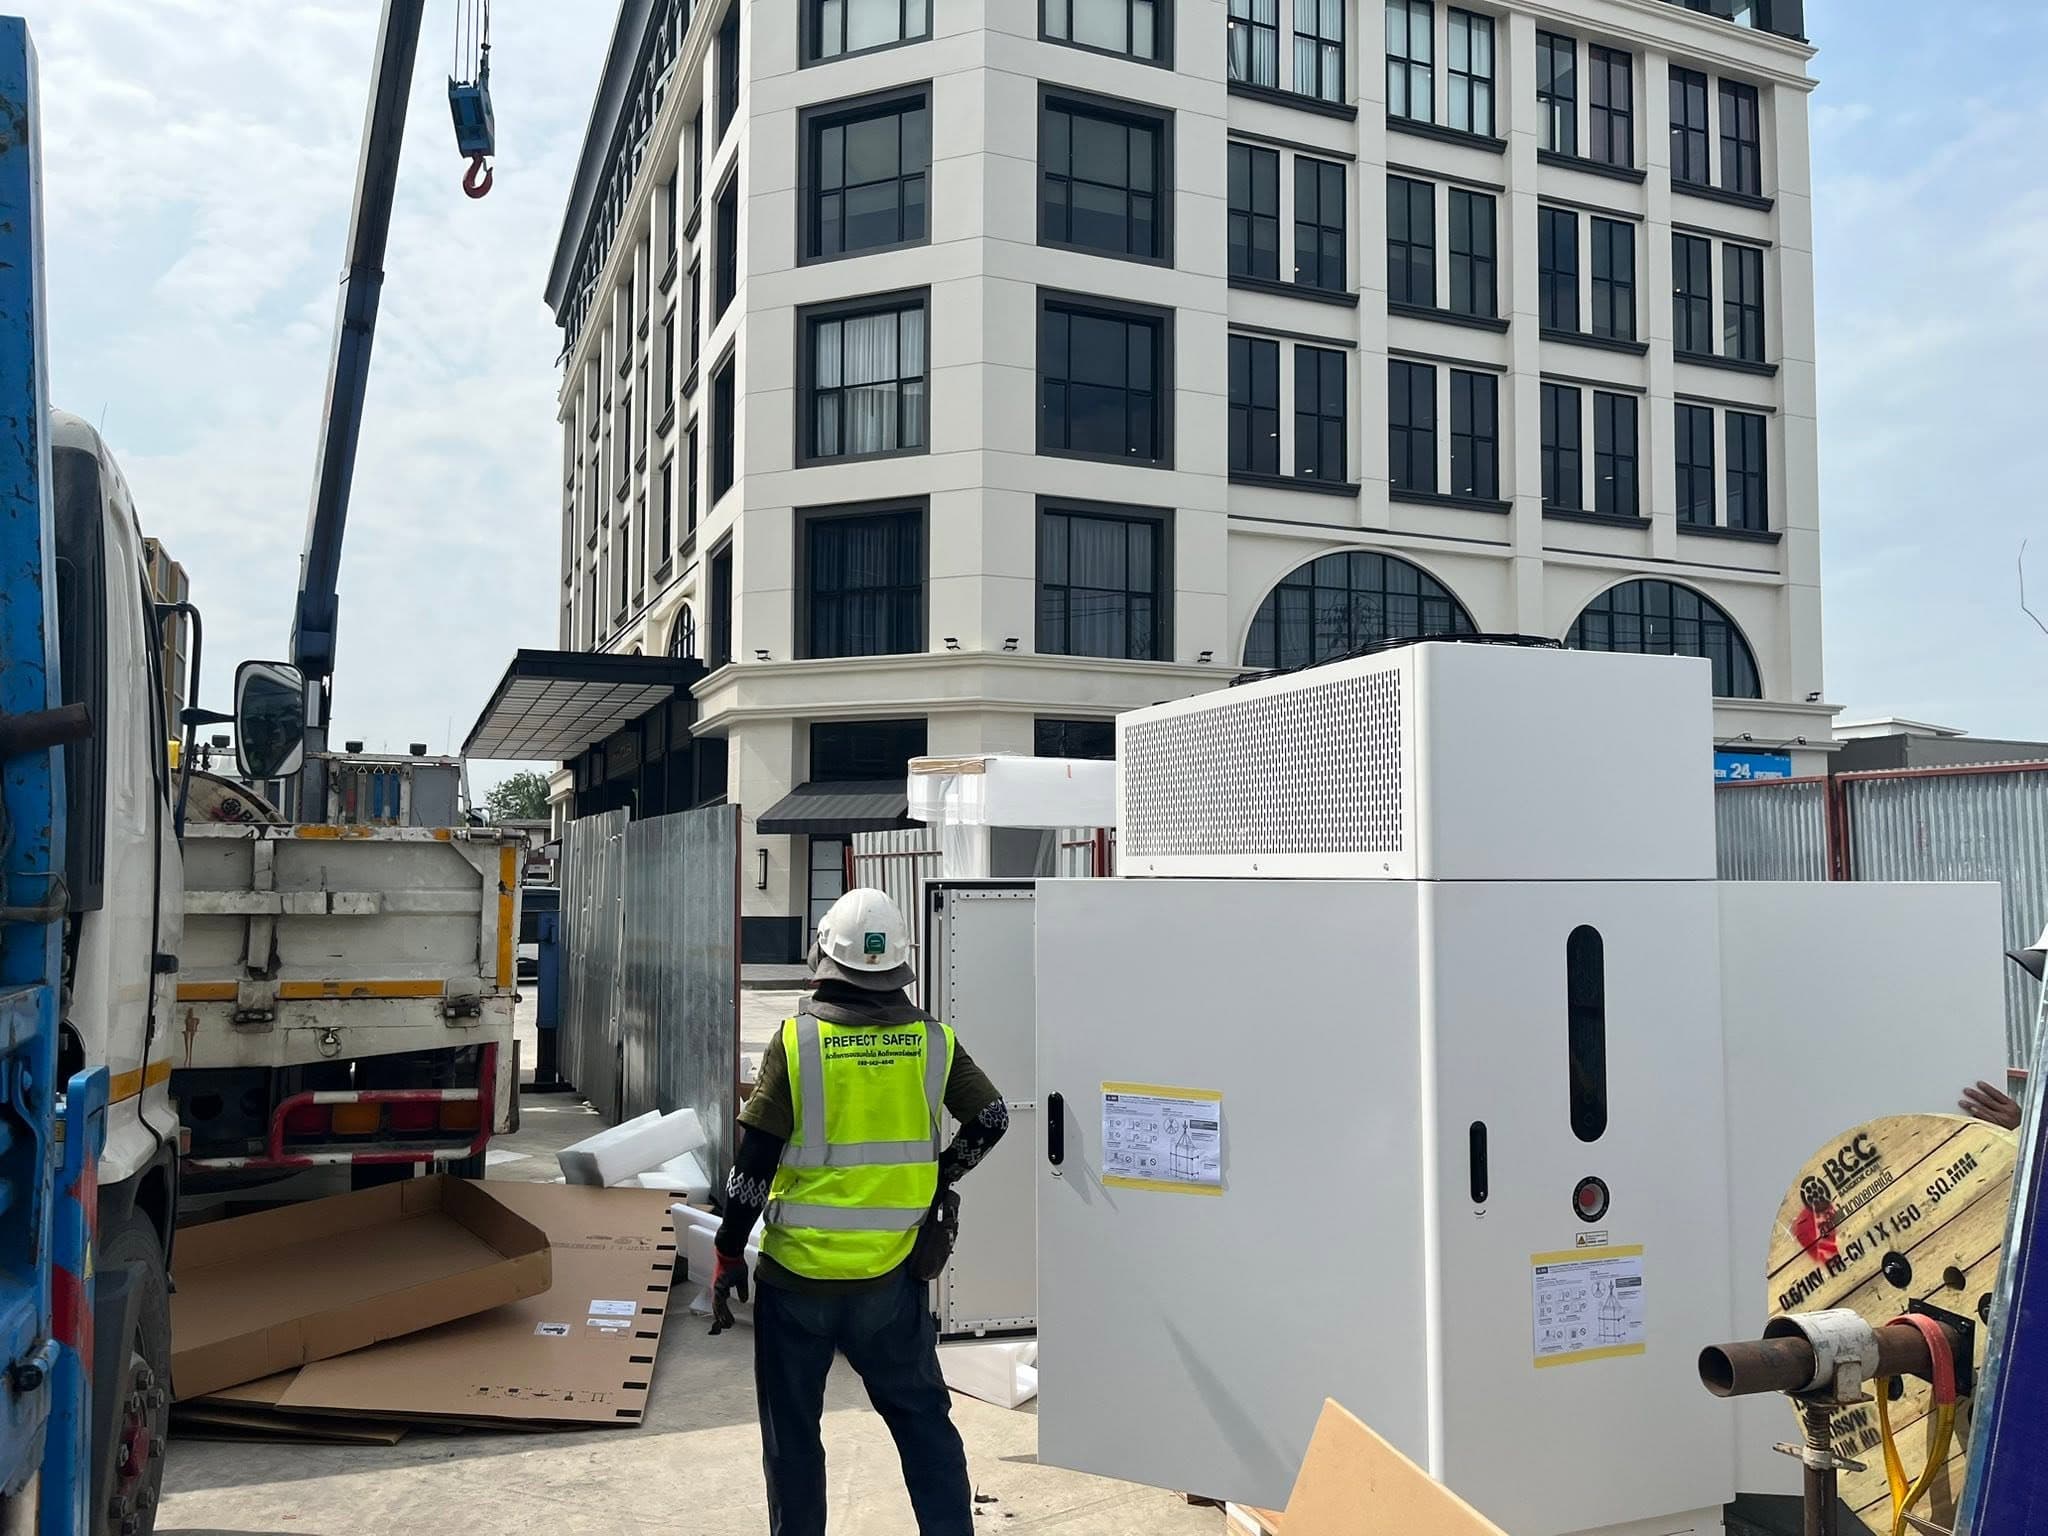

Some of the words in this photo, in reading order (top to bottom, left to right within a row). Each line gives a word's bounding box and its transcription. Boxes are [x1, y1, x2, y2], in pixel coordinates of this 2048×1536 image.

[1730, 763, 1751, 779] 24
[823, 1034, 877, 1048] PREFECT
[882, 1033, 922, 1046] SAFETY
[1822, 1133, 1877, 1190] BCC
[1779, 1267, 1825, 1311] 0.6/1KV
[1866, 1229, 1878, 1247] 1
[1890, 1204, 1921, 1233] 150
[1926, 1152, 1978, 1203] SQ.MM
